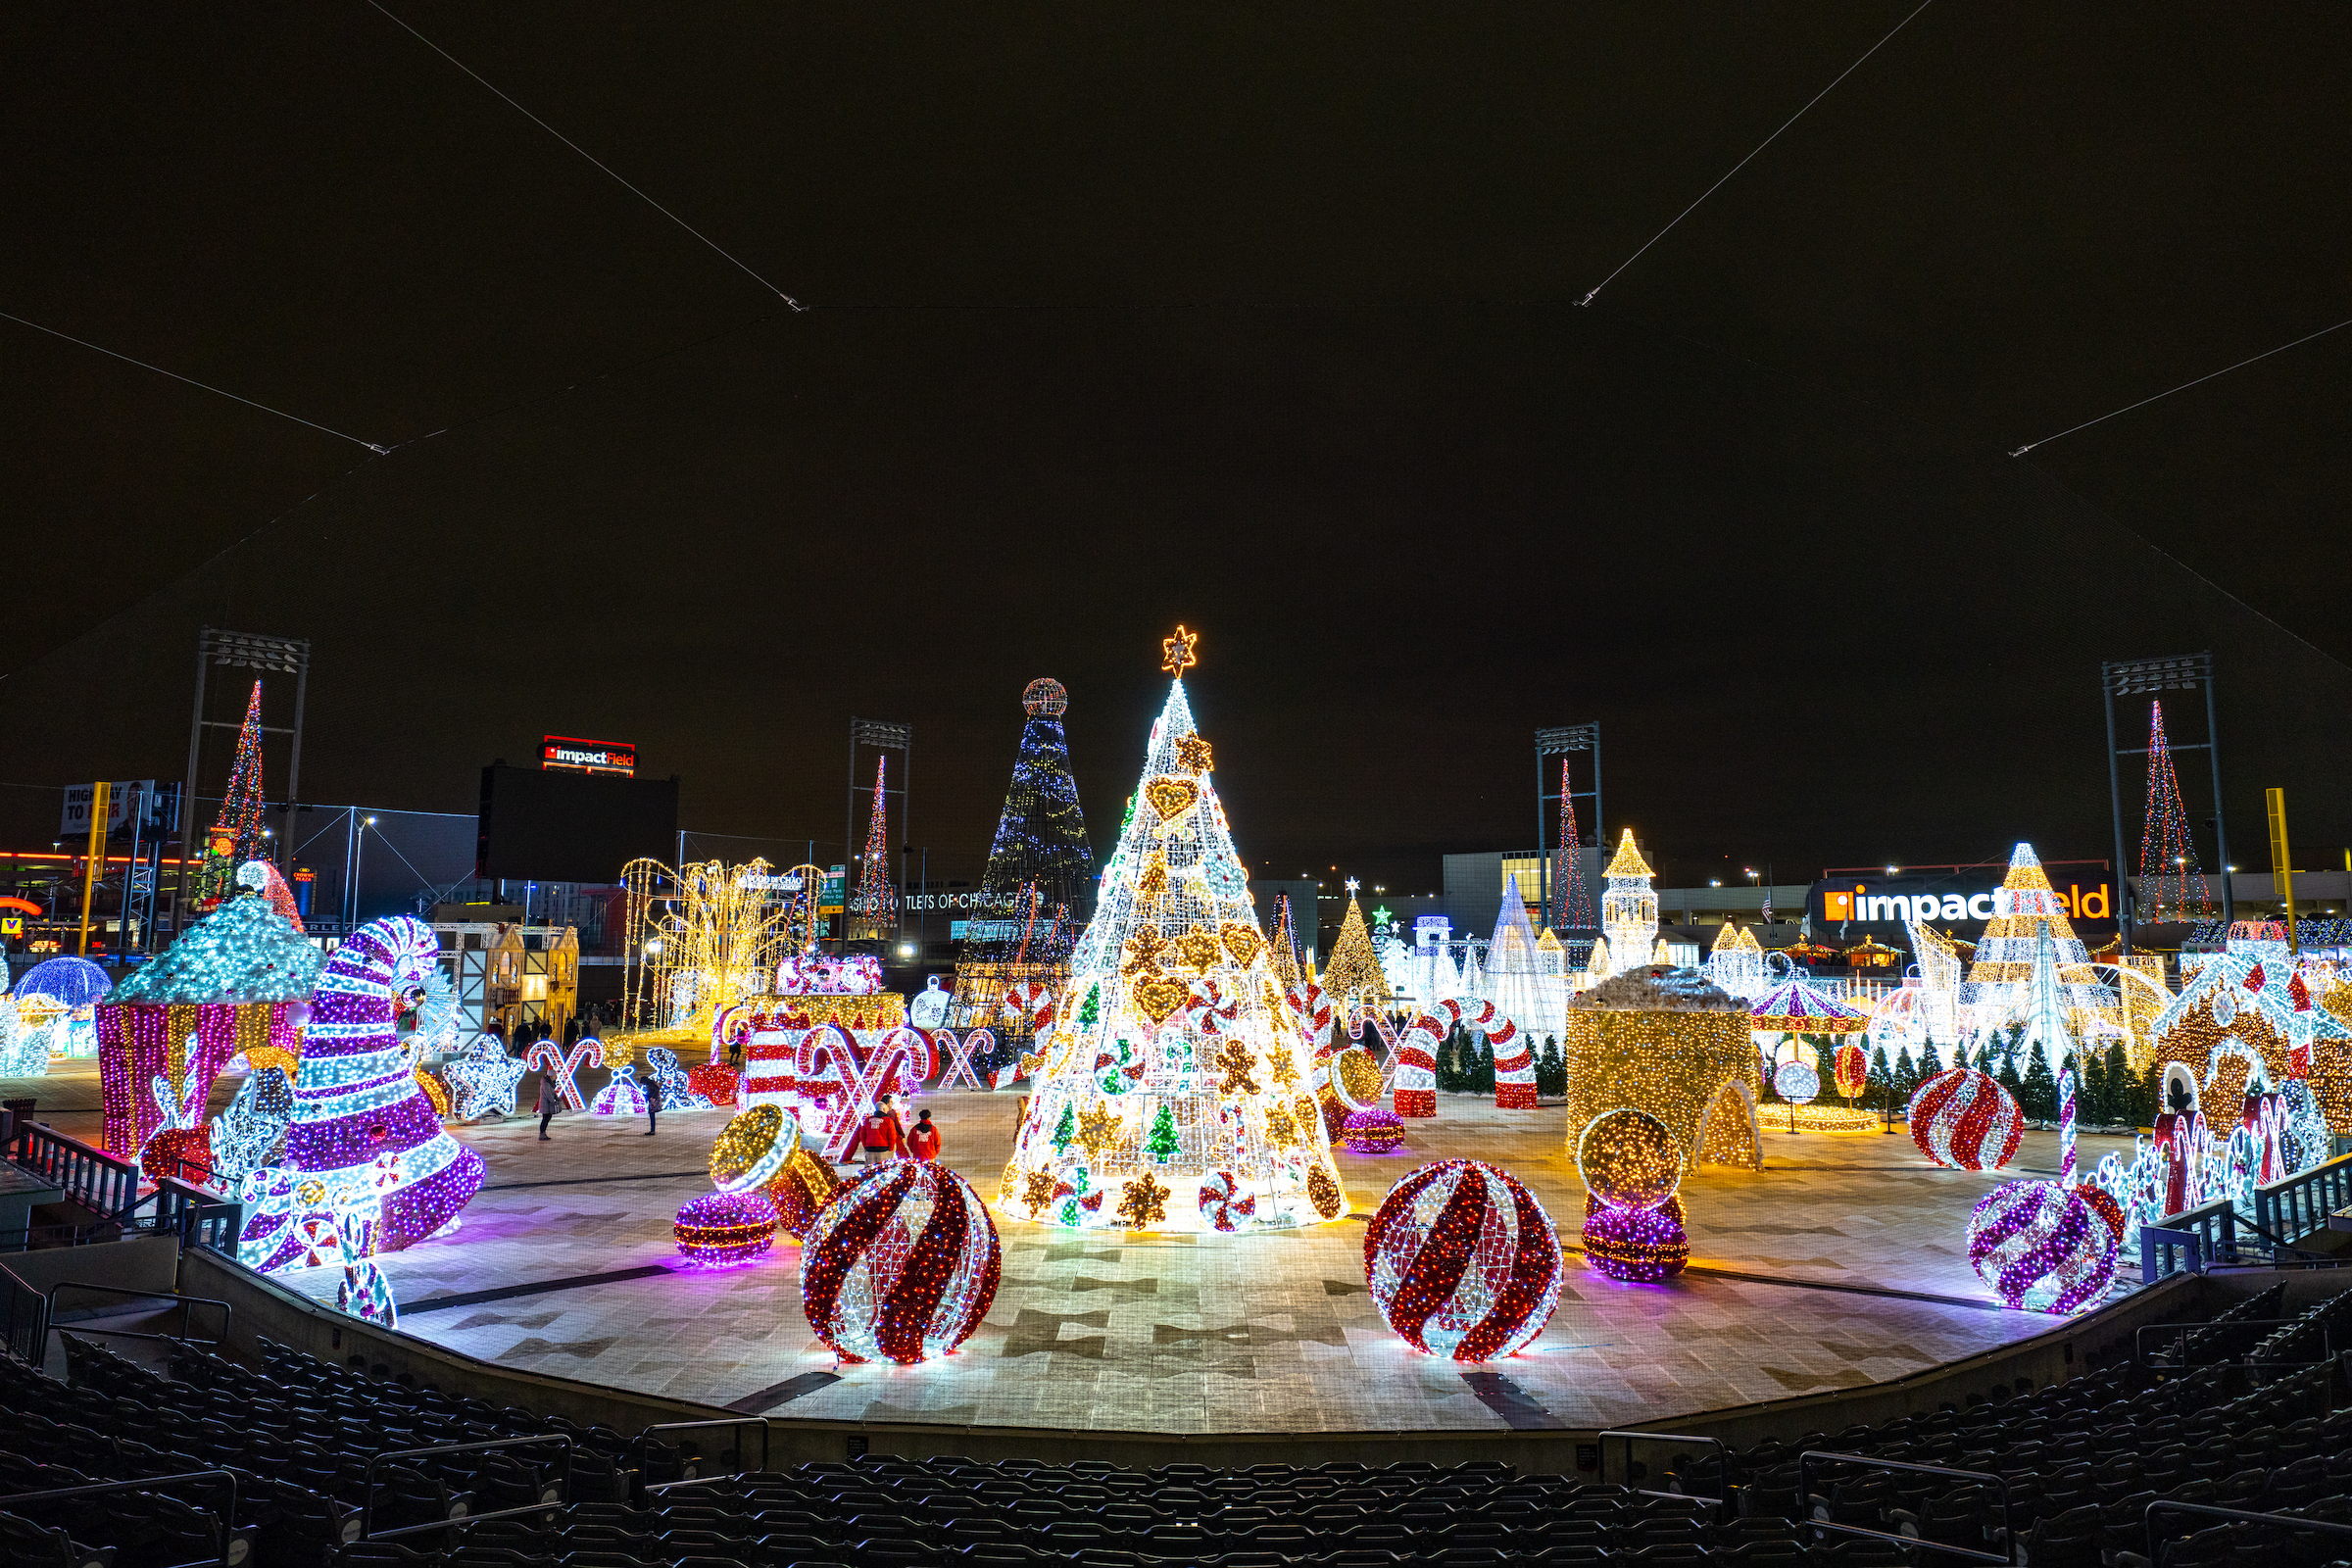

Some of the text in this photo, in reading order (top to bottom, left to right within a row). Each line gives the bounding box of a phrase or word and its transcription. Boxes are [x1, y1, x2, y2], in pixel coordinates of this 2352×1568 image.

[69, 786, 122, 803] HIGHAY
[68, 804, 84, 820] TO
[938, 893, 956, 909] OF
[958, 892, 1020, 909] CHICAG
